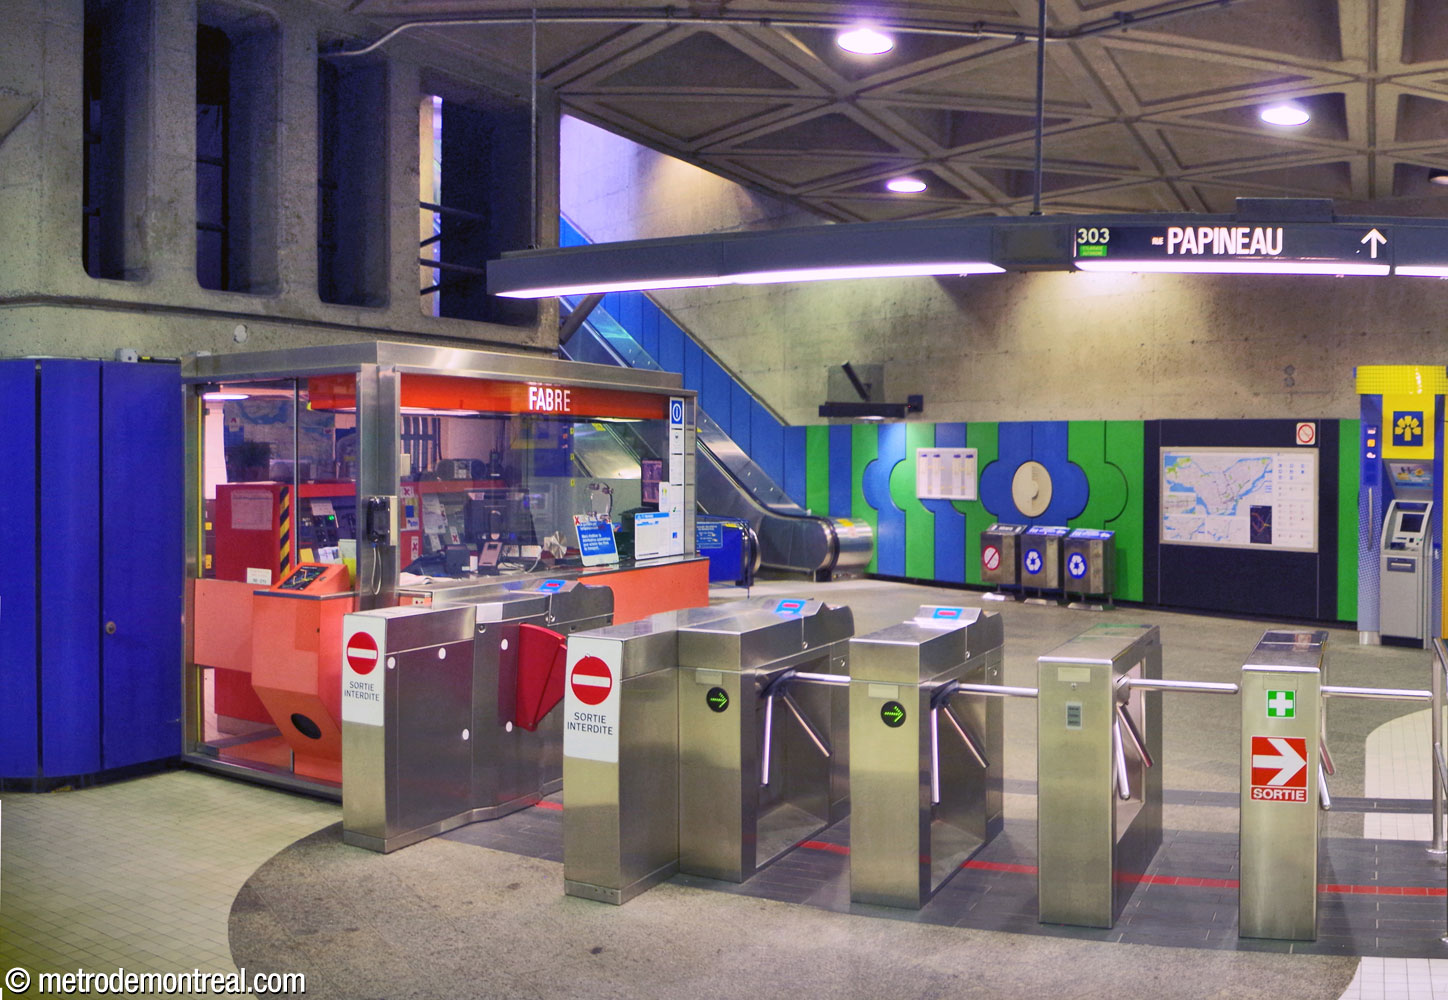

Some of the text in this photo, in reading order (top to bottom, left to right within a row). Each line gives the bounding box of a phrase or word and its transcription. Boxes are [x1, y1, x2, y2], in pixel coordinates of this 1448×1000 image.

[1077, 227, 1110, 244] 303
[1167, 226, 1283, 255] PAPINEAU
[529, 387, 570, 411] FABRE
[349, 681, 374, 691] SORTIE
[344, 690, 380, 701] INTERDITE
[574, 712, 606, 724] SORTIE
[567, 721, 613, 735] INTERDITE
[1253, 788, 1305, 800] SORTIE
